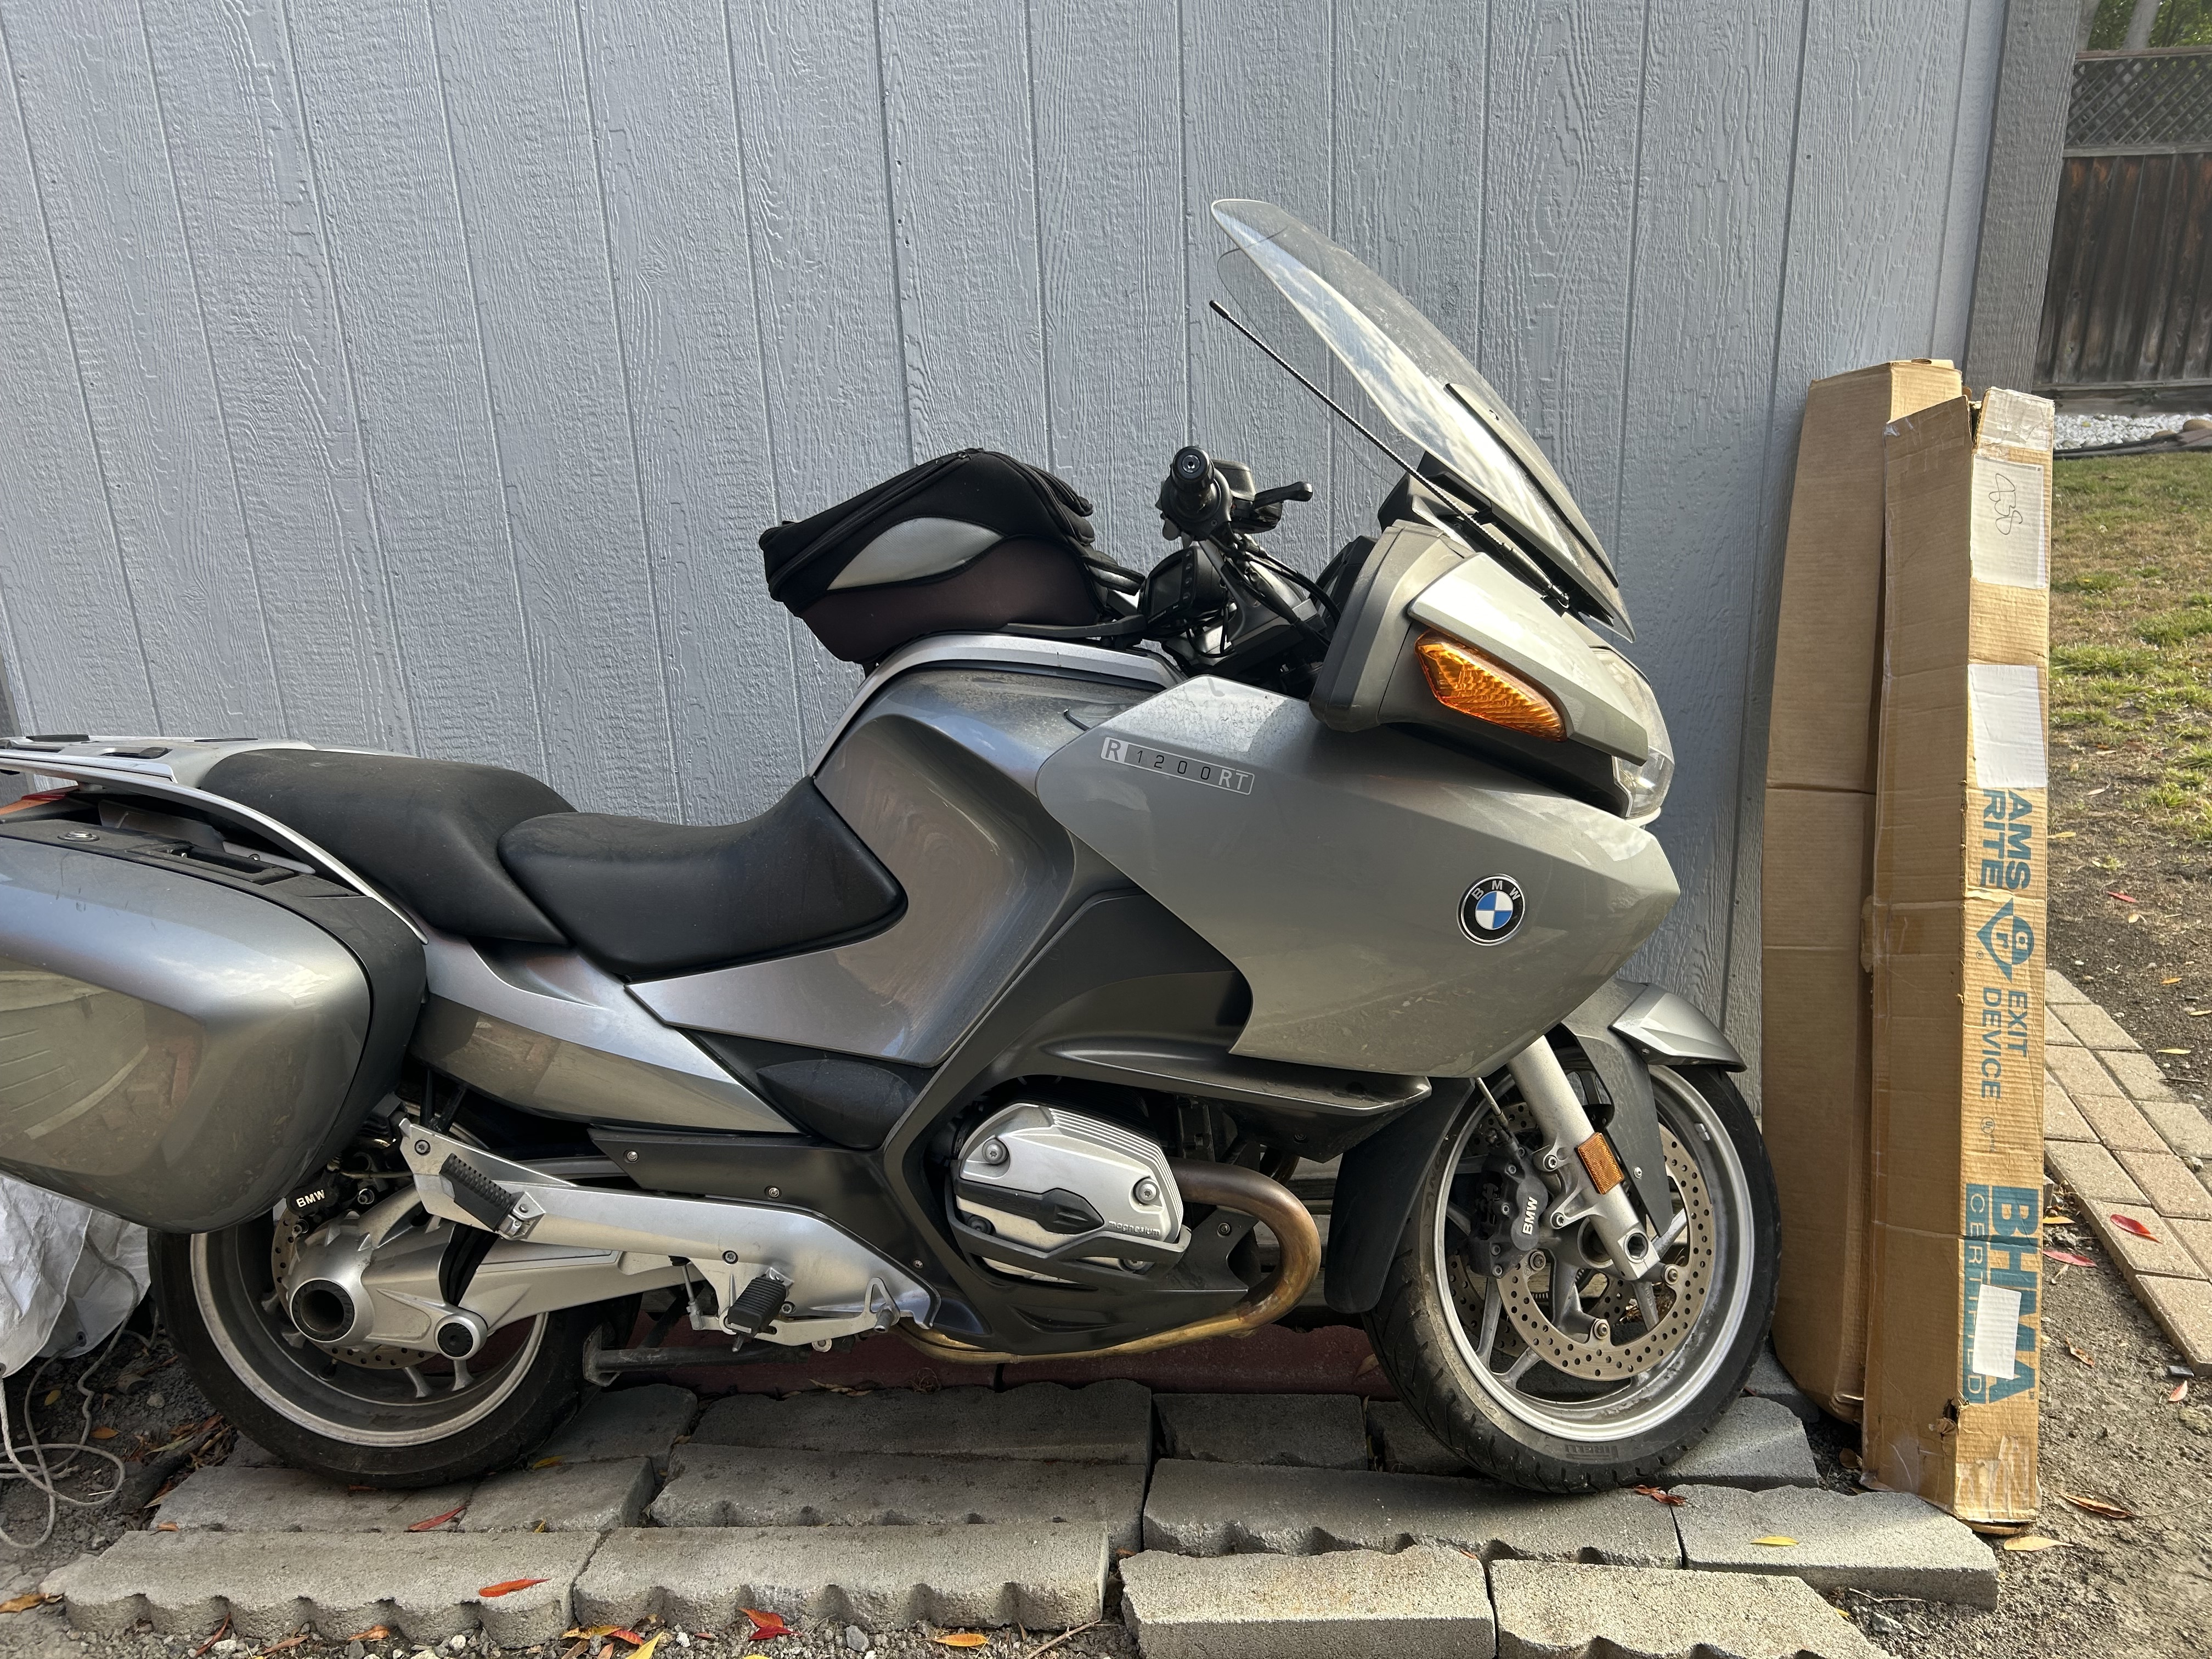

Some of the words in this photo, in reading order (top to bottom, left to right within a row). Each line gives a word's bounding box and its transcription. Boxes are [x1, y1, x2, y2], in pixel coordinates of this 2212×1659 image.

[1980, 789, 2006, 888] RITE
[2006, 788, 2033, 890] AMS
[1471, 880, 1521, 900] BMW
[1981, 986, 2002, 1099] DEVICE
[2007, 990, 2028, 1058] EXIT
[296, 1189, 325, 1208] BMW
[1522, 1197, 1538, 1235] BMW
[1108, 1220, 1161, 1235] magnesium
[1565, 1444, 1619, 1461] PIRELLI
